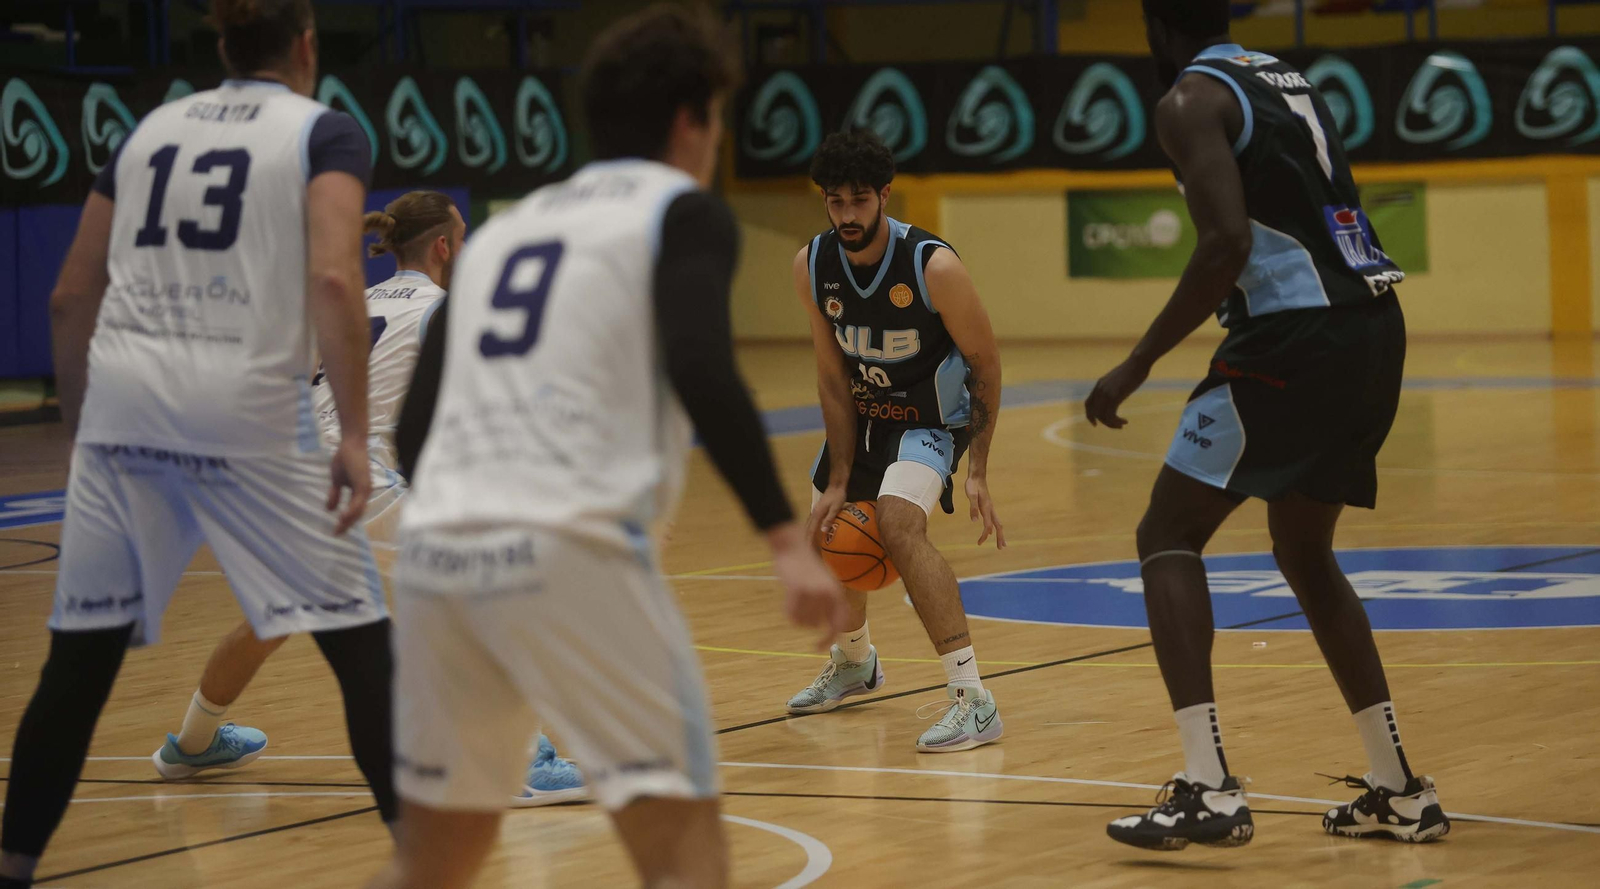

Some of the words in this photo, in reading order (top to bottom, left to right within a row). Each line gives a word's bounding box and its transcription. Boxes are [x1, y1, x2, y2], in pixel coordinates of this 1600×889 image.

[135, 144, 251, 251] 13
[477, 238, 565, 360] 9
[858, 362, 892, 388] 10
[921, 439, 945, 457] vive
[1183, 428, 1213, 450] vive
